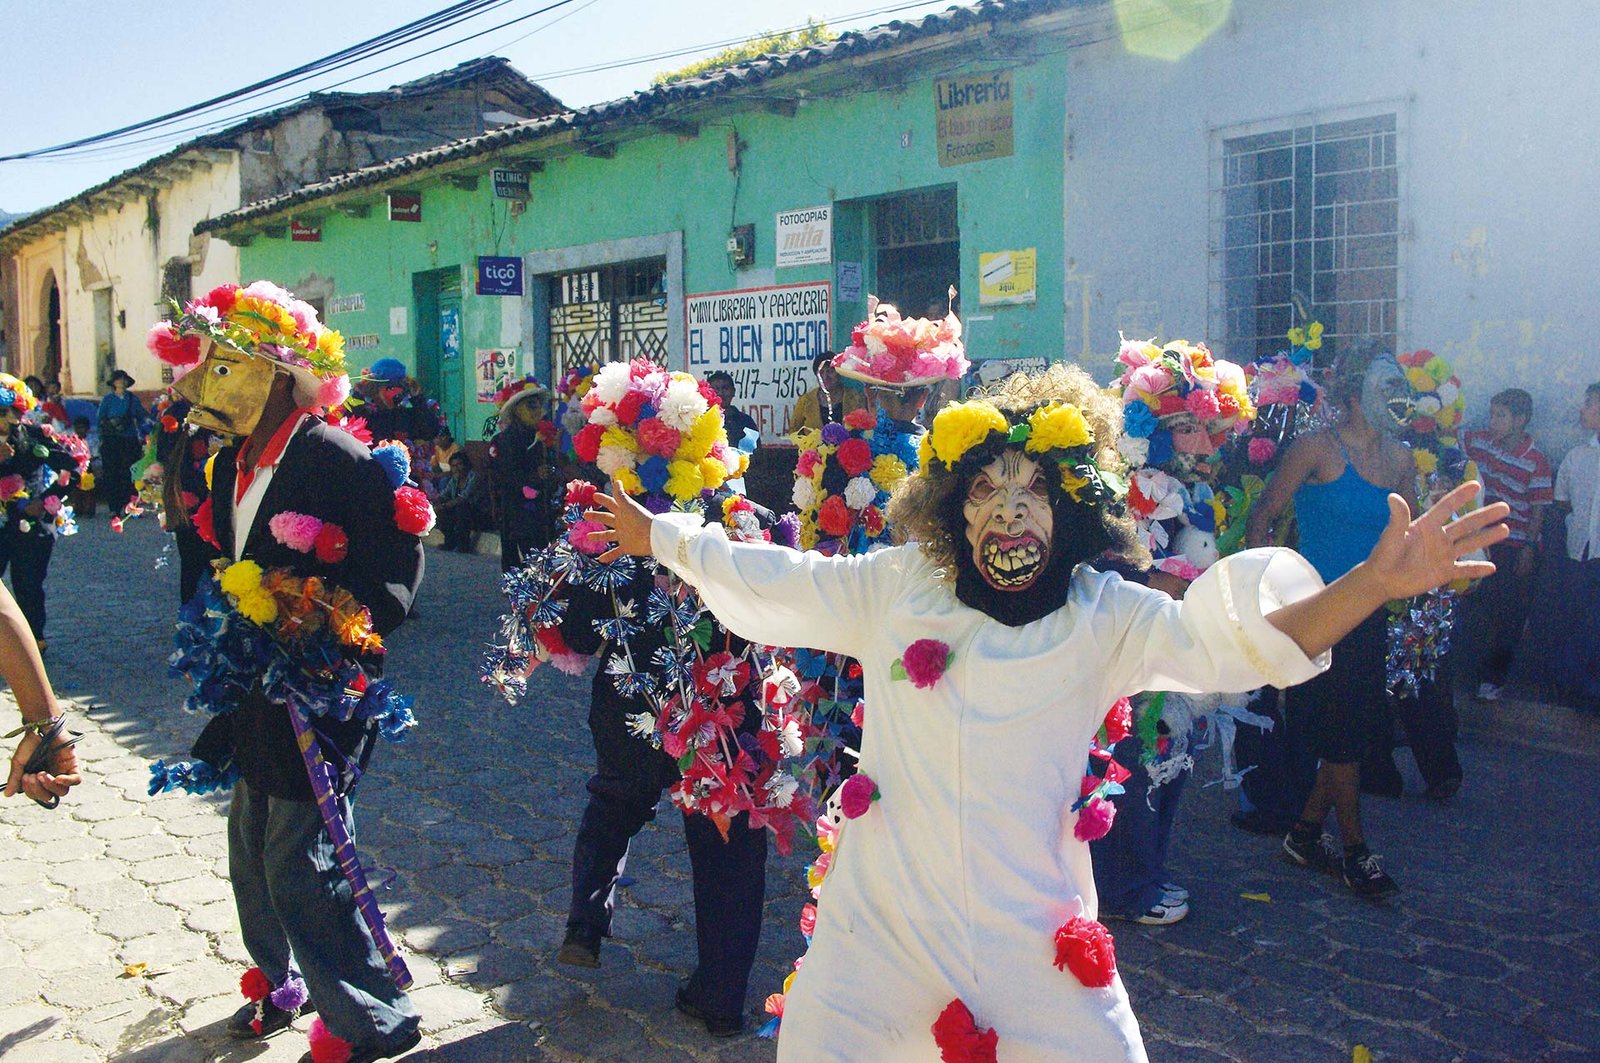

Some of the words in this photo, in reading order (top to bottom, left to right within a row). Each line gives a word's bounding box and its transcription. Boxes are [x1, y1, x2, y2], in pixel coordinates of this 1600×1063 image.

[780, 209, 828, 226] FOTOCOPIAS
[689, 301, 711, 324] MINI
[712, 297, 756, 322] LIBRERIA
[758, 295, 768, 318] Y
[769, 288, 829, 318] PAPELERIA
[690, 329, 710, 365] EL
[719, 324, 763, 364] BUEN
[772, 319, 828, 362] PRECIO
